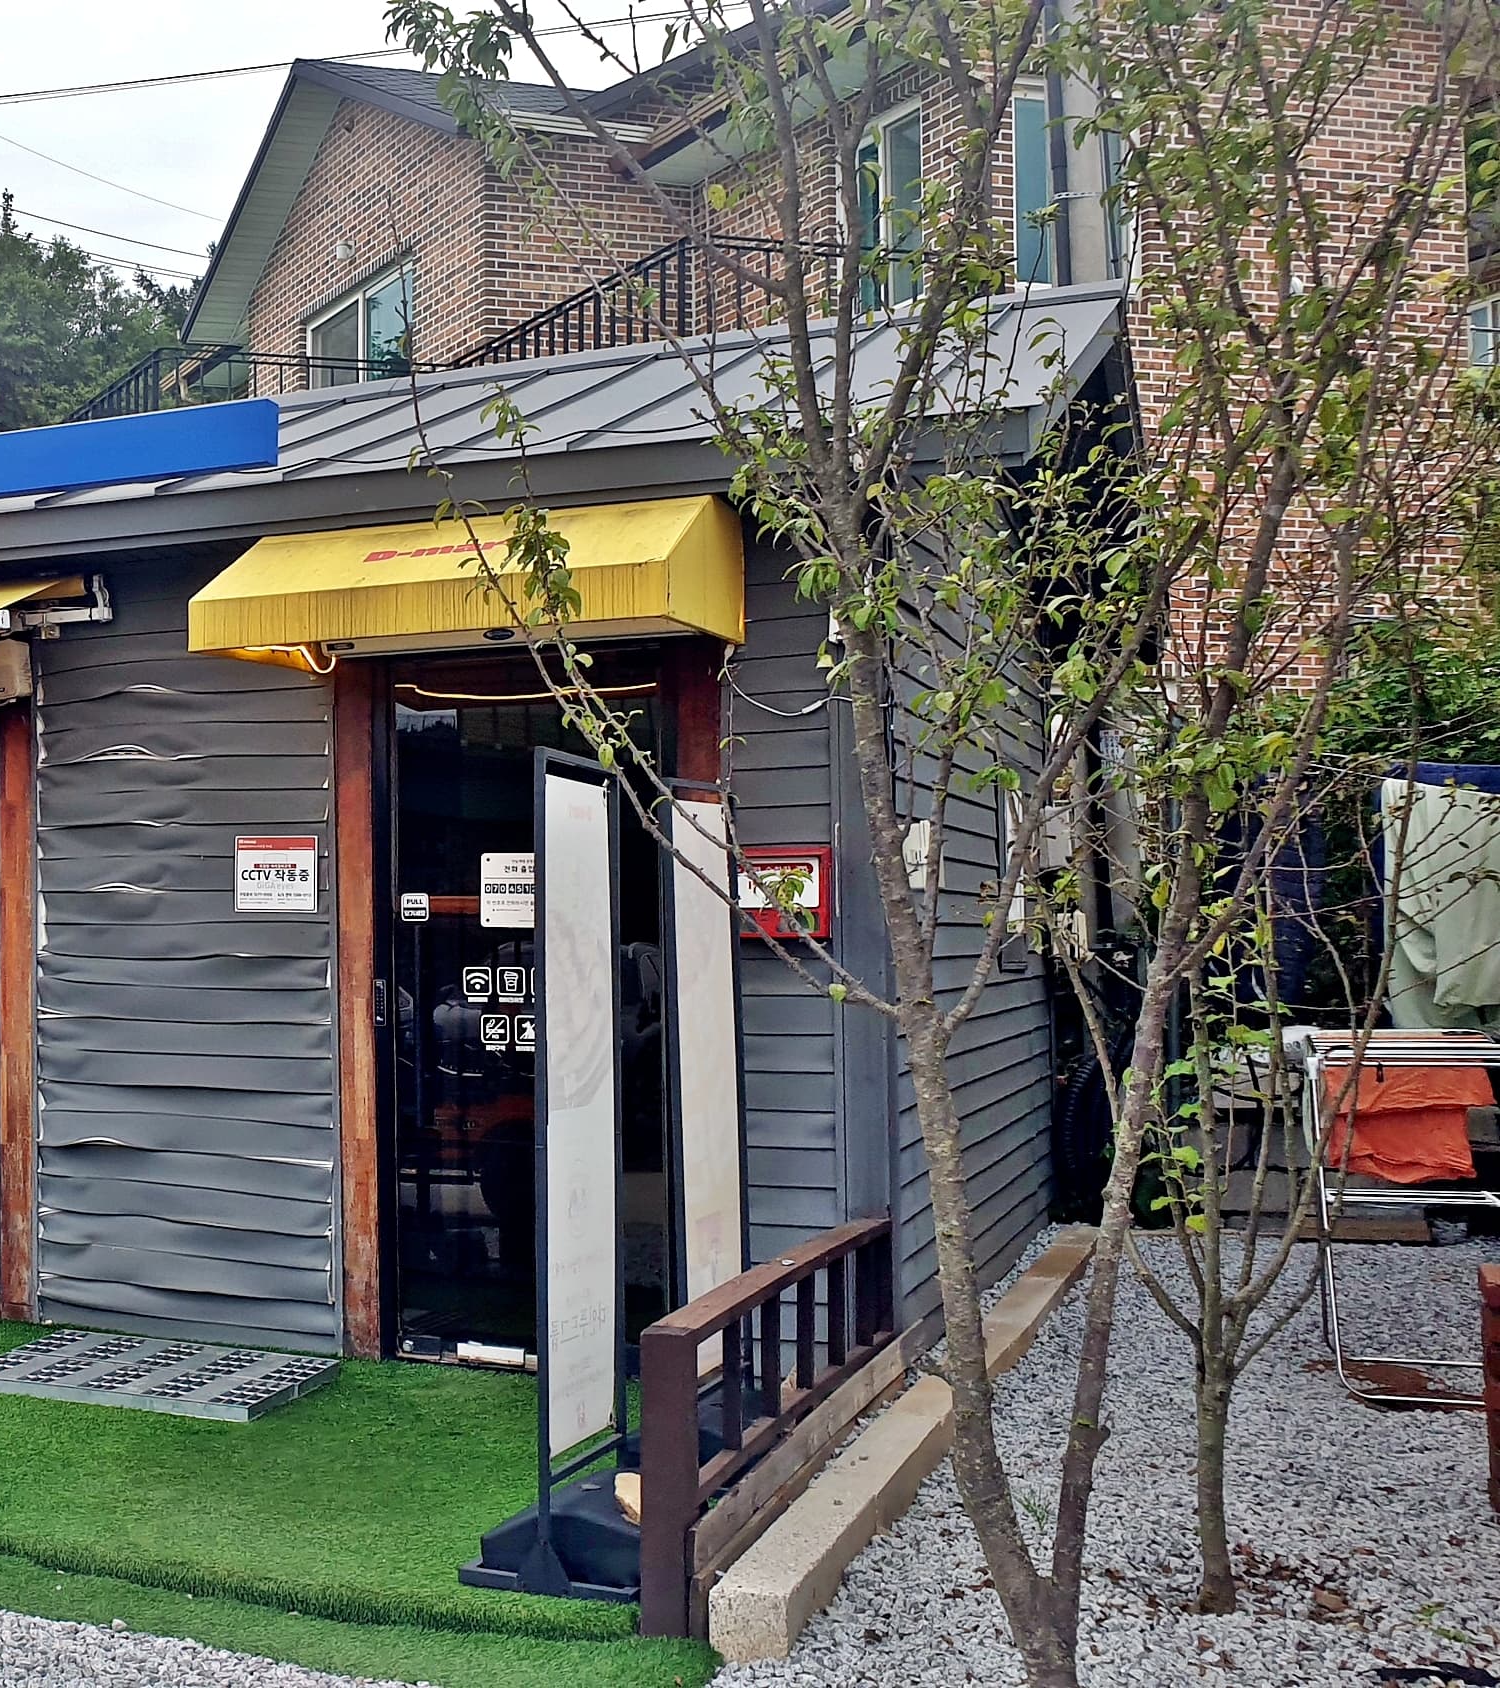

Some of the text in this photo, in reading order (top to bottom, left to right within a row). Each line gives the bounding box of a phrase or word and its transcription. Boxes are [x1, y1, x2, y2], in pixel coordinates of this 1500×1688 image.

[363, 540, 509, 563] D-mar
[241, 869, 310, 882] CCTV 작동중
[484, 884, 507, 894] 070
